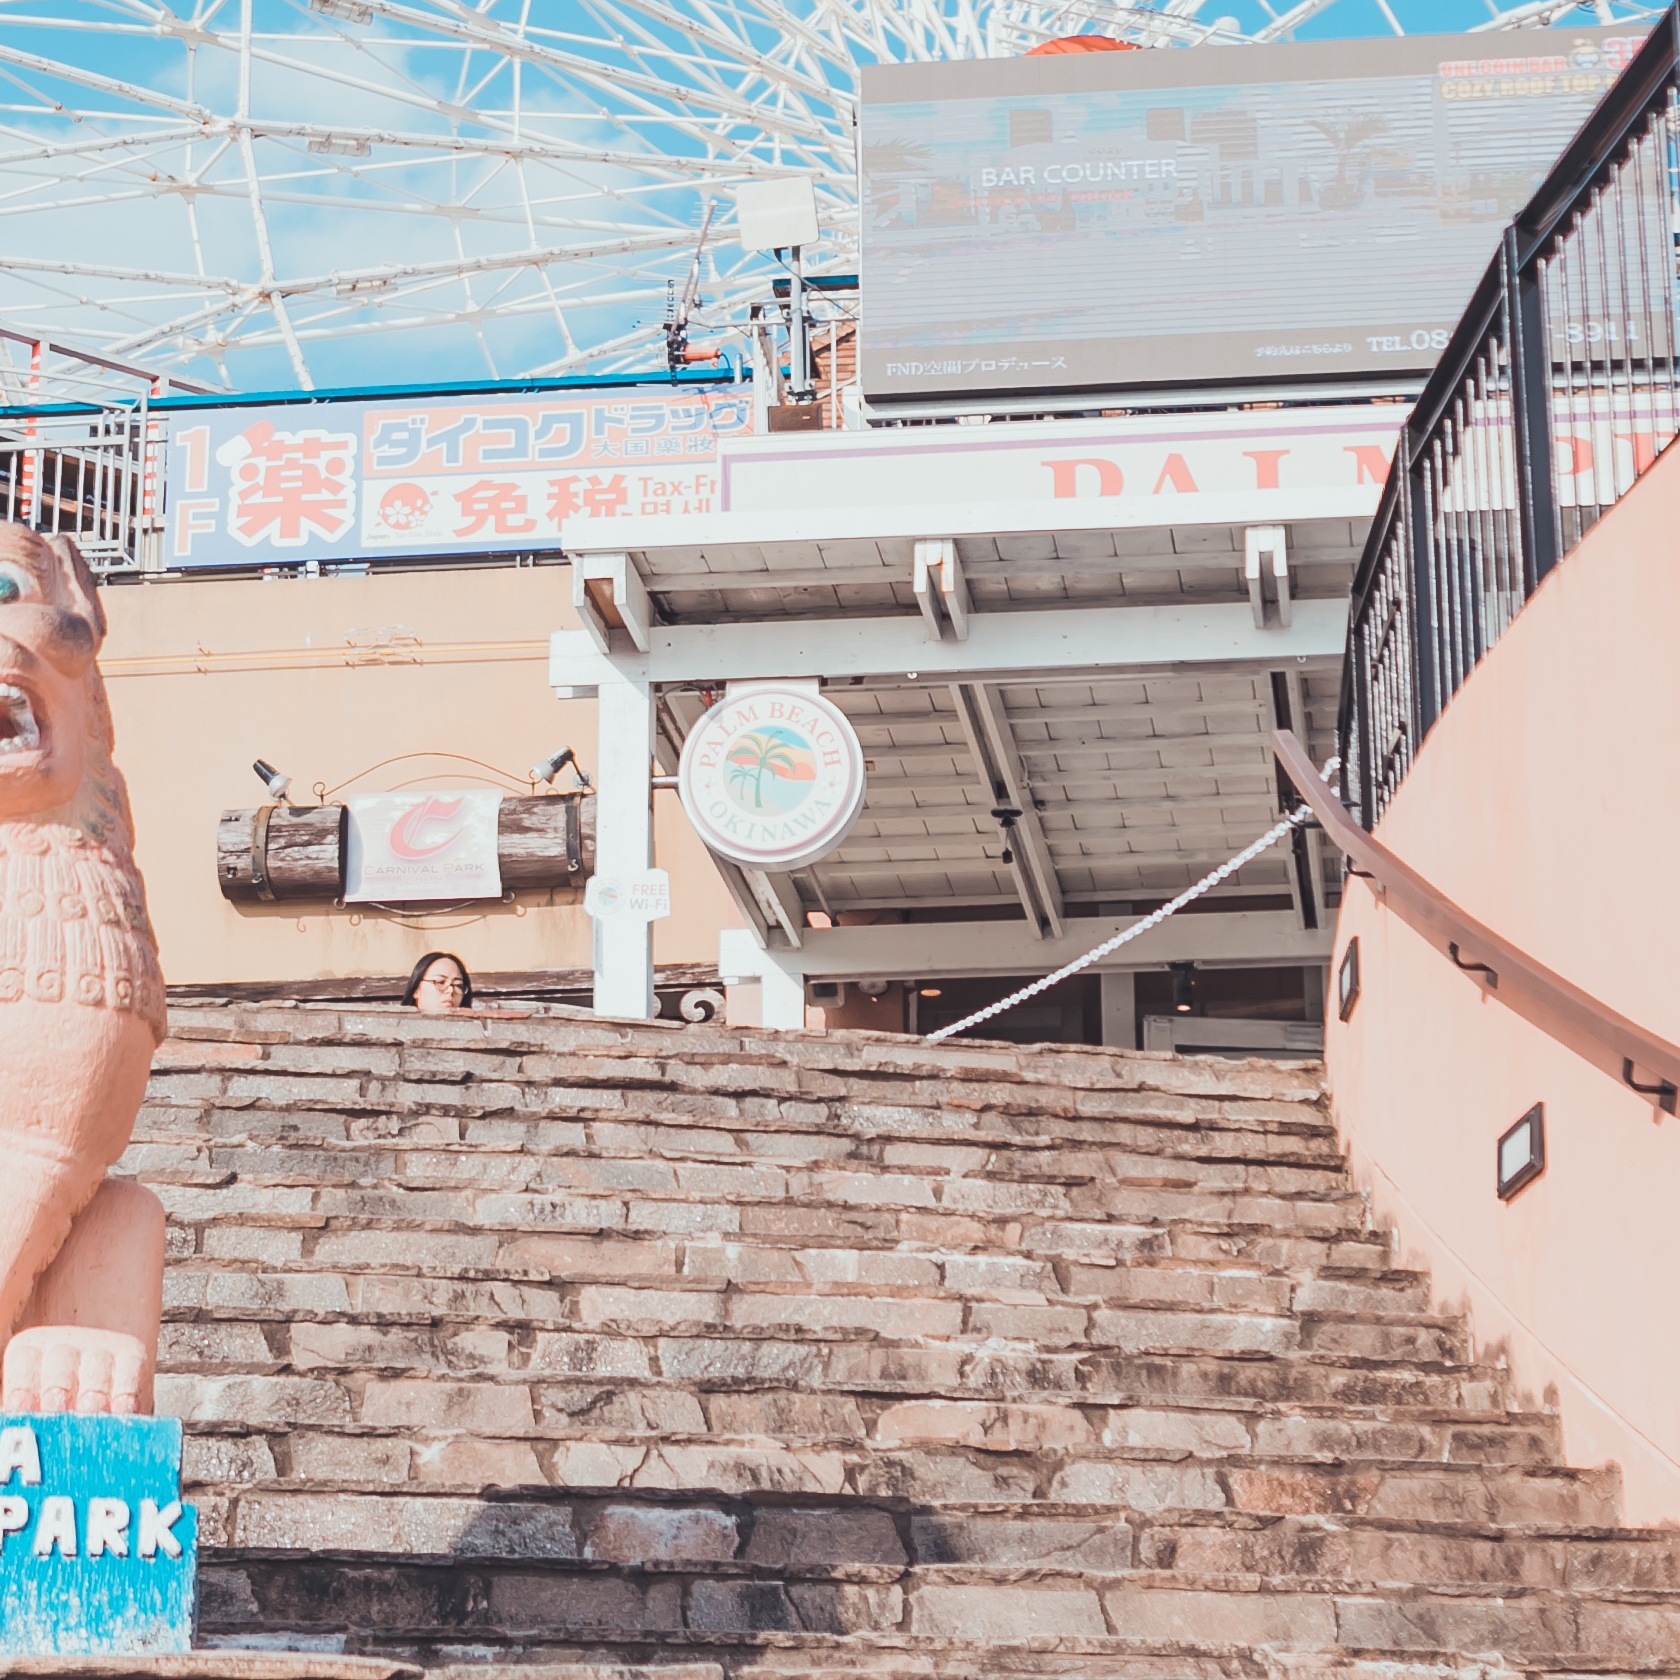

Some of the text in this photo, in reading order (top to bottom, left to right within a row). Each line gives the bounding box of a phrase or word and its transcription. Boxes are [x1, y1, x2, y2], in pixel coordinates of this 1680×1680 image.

[1439, 60, 1477, 78] ONE
[1479, 57, 1526, 76] COIN
[1527, 55, 1568, 75] BAR
[1440, 80, 1495, 100] COZY
[1500, 77, 1556, 96] ROOF
[1560, 74, 1602, 94] TOP
[981, 159, 1179, 187] BAR COUNTER
[637, 474, 716, 498] Tax-Fr
[452, 475, 633, 538] 免税
[699, 701, 843, 769] PALM BEACH
[709, 799, 833, 842] OKINAWA
[364, 863, 485, 876] CARNIVAL PARK
[632, 883, 667, 896] FREE
[629, 898, 668, 911] Wi-Fi
